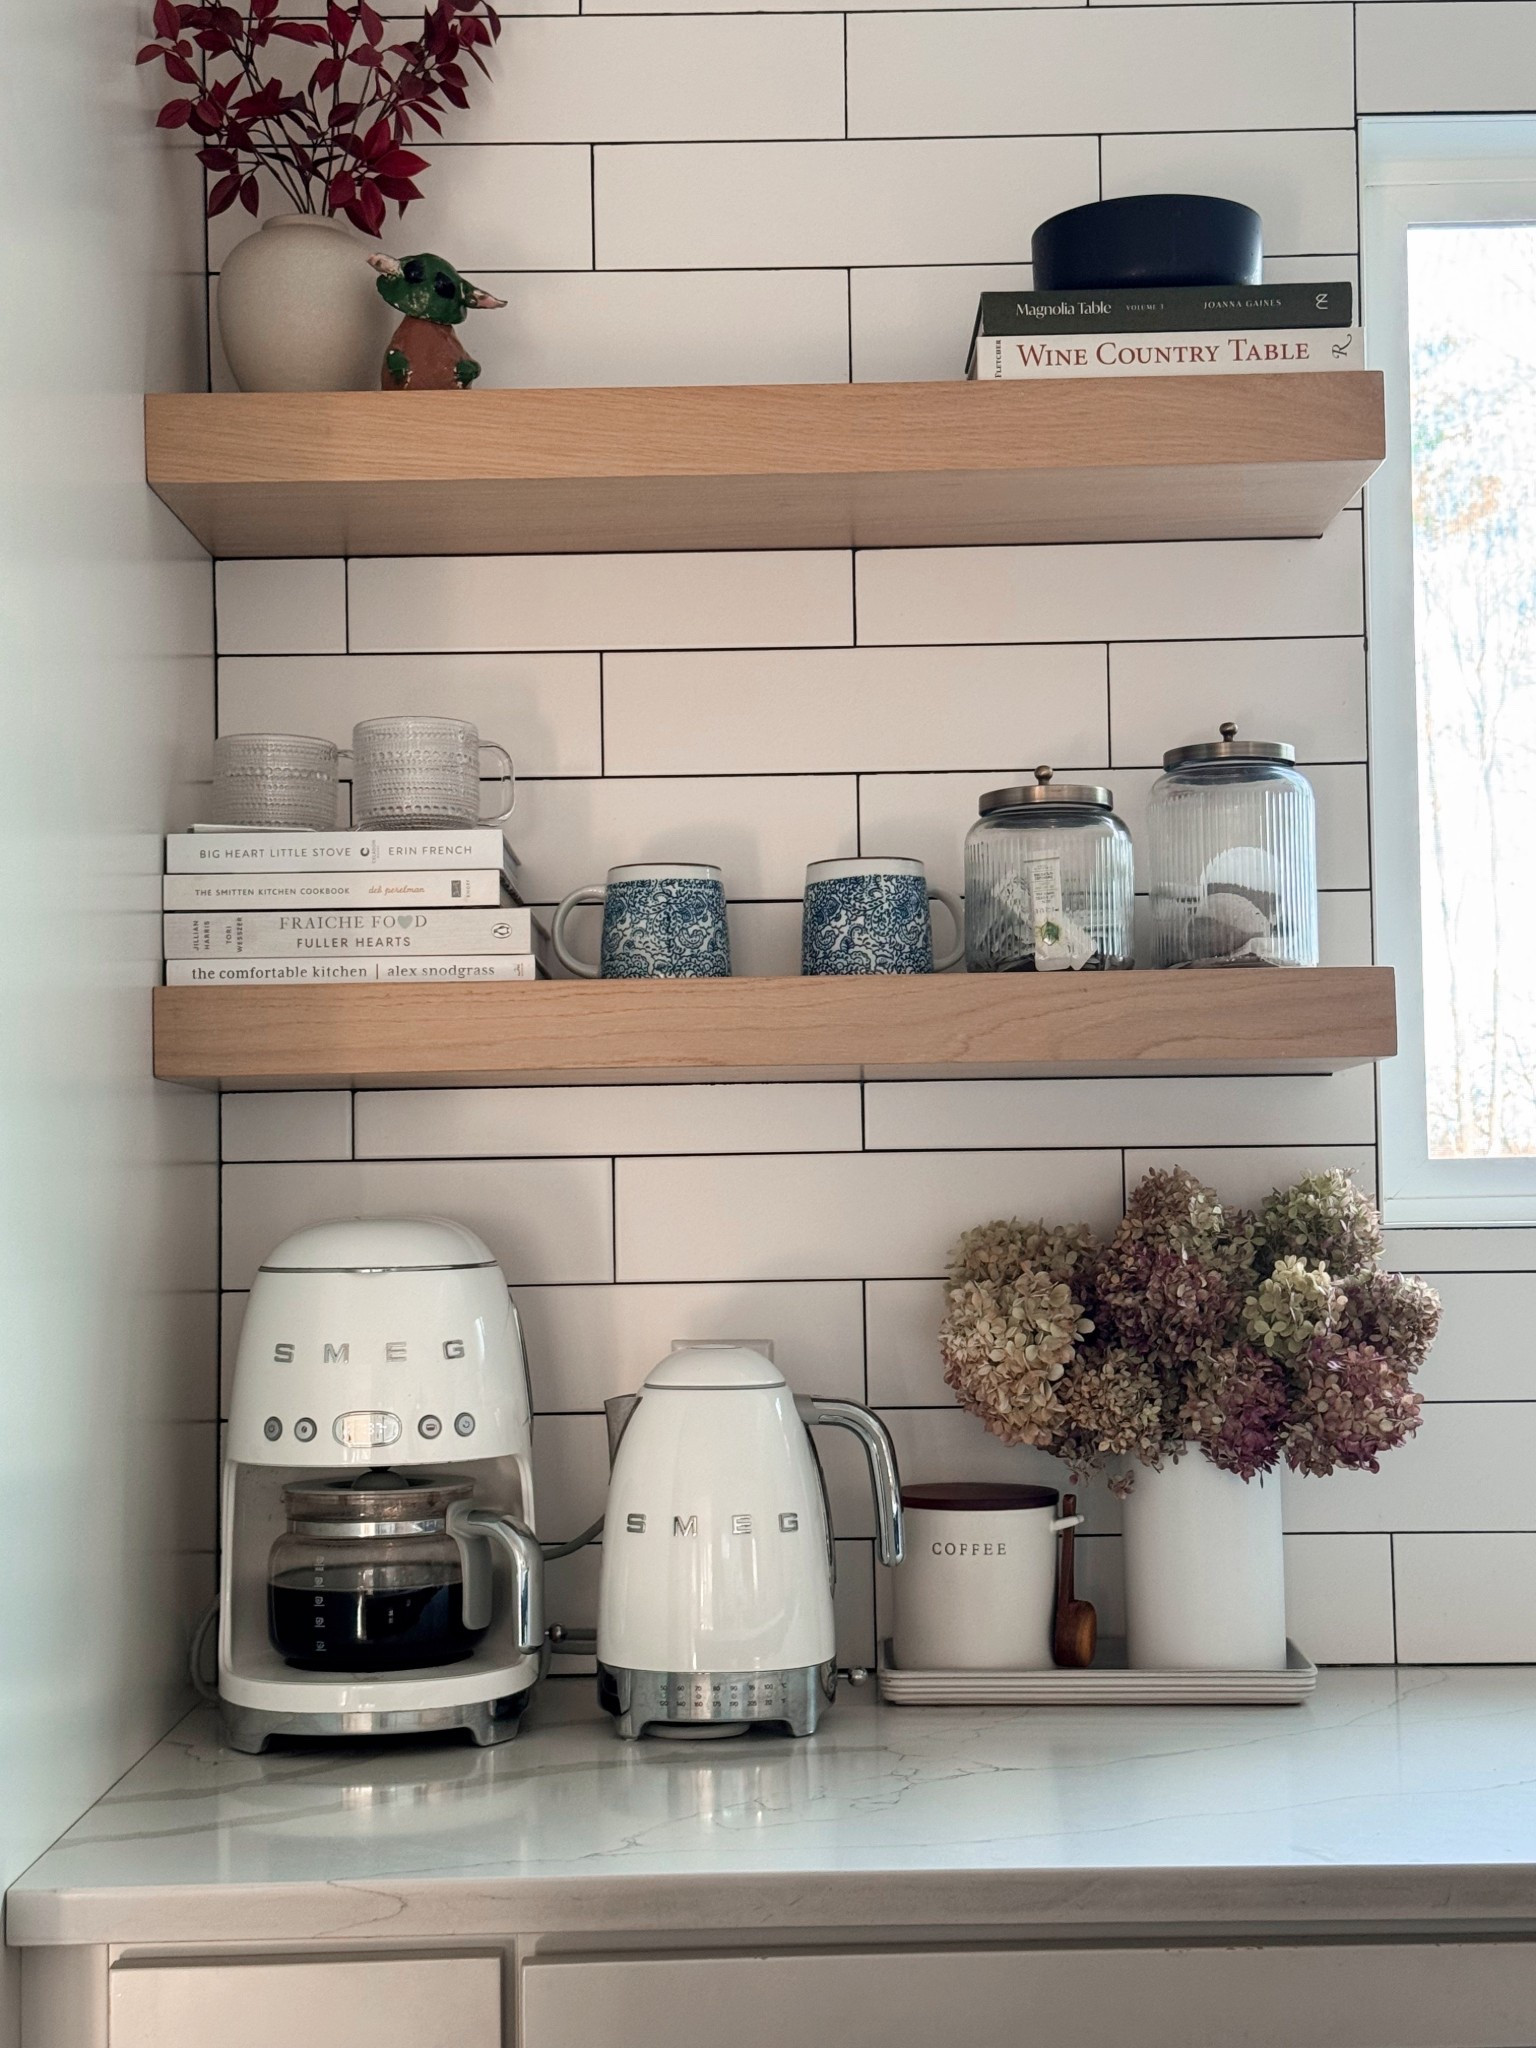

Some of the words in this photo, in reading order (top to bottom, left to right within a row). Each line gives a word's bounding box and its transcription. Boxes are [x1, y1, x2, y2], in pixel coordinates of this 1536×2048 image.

[1016, 302, 1075, 318] Magnolia
[1077, 301, 1112, 314] Table
[1203, 300, 1242, 310] JOANNA
[1245, 299, 1282, 308] GAINES
[1016, 344, 1087, 366] WINE
[1096, 342, 1219, 365] COUNTRY
[1228, 339, 1309, 361] TABLE
[199, 849, 221, 859] BIG
[224, 848, 265, 859] HEART
[269, 848, 308, 858] LITTLE
[312, 847, 351, 858] STOVE
[388, 846, 417, 856] ERIN
[421, 845, 472, 856] FRENCH
[194, 888, 212, 897] THE
[215, 888, 255, 897] SMITTEN
[257, 888, 297, 896] KITCHEN
[299, 887, 350, 896] COOKBOOK
[368, 884, 383, 894] deb
[383, 884, 426, 897] perelman
[279, 915, 364, 930] FRAICHE
[192, 920, 200, 952] JILLIAN
[203, 920, 211, 950] HARRIS
[225, 925, 233, 945] TORI
[296, 937, 349, 949] FULLER
[355, 936, 411, 948] HEARTS
[191, 967, 216, 980] the
[218, 966, 308, 980] comfortable
[312, 965, 367, 978] kitchen
[387, 964, 418, 977] alex
[421, 963, 496, 979] snodgrass
[274, 1339, 465, 1364] SMEG
[627, 1513, 799, 1537] SMEG
[932, 1542, 1007, 1556] COFFEE
